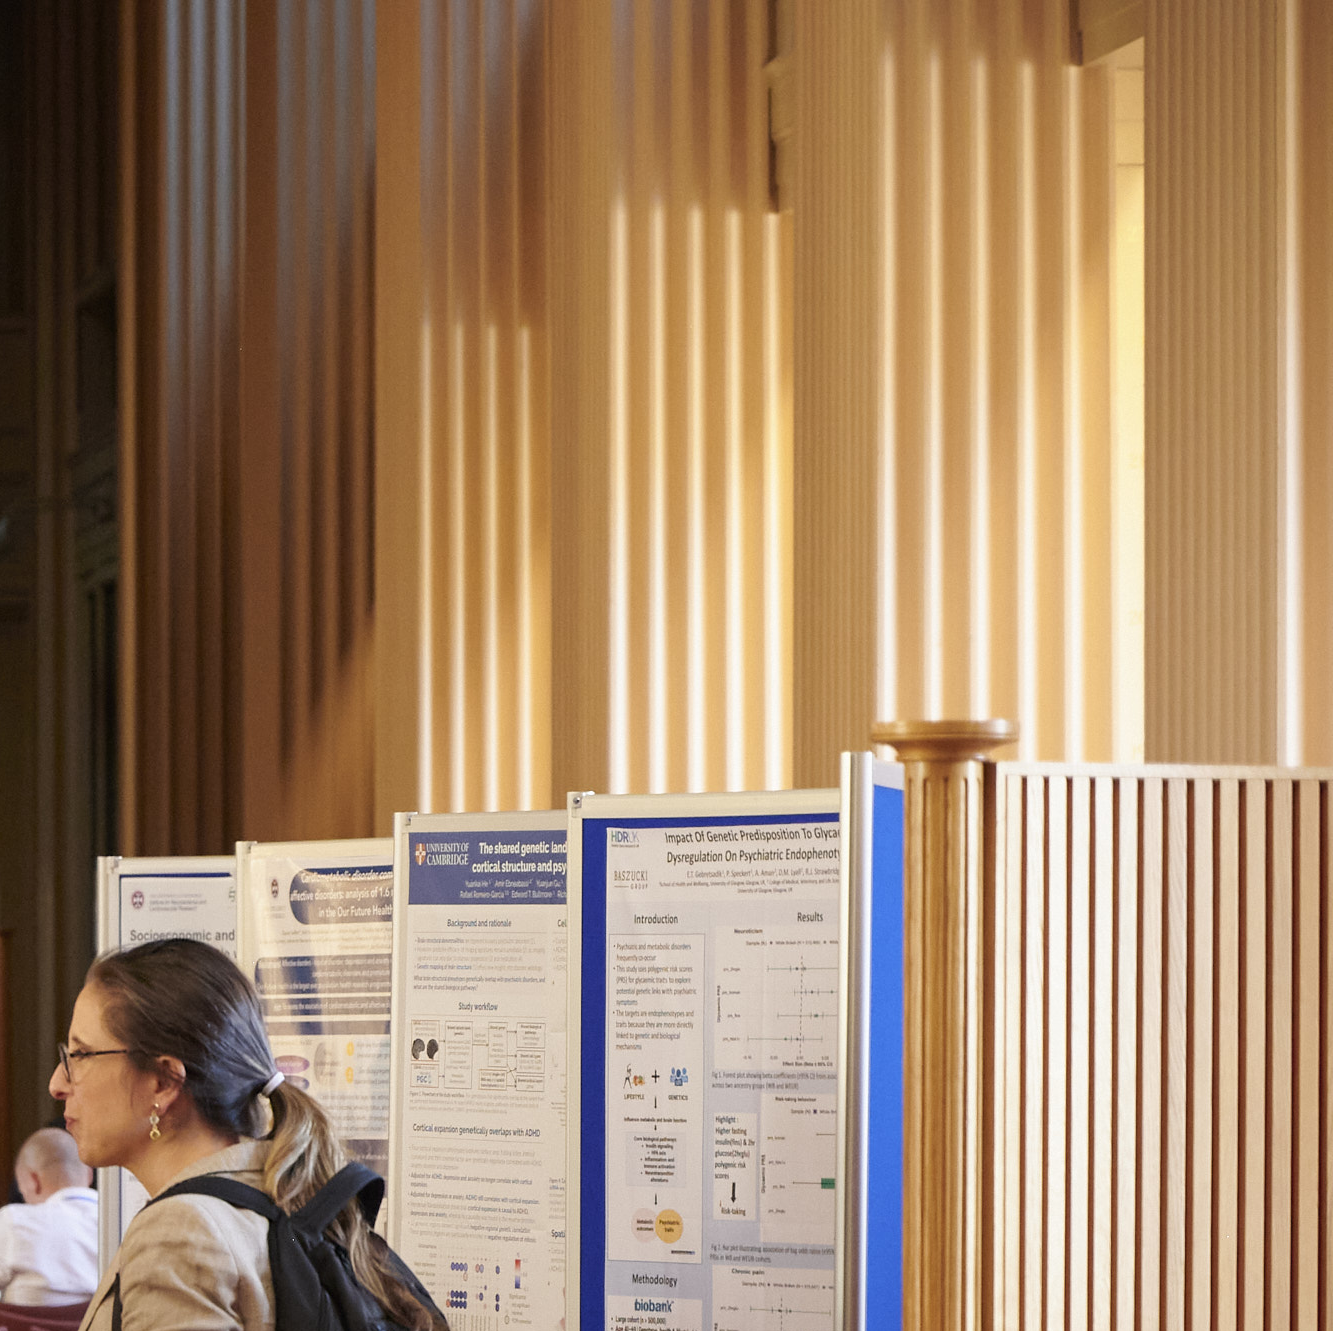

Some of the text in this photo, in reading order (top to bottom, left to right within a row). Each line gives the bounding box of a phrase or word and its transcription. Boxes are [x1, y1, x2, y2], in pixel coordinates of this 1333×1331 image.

[666, 832, 692, 845] Impact
[694, 831, 704, 843] Of
[707, 830, 737, 842] Genetic
[740, 829, 800, 844] Predisposition
[479, 842, 493, 854] The
[495, 842, 520, 854] shared
[521, 841, 549, 856] genetic
[667, 851, 722, 865] Dysregulation
[739, 850, 783, 862] Psychiatric
[472, 861, 500, 873] cortical
[346, 889, 369, 901] analysis
[130, 929, 212, 941] Socioeconomic
[459, 1125, 488, 1137] genetically
[632, 1274, 677, 1286] Methodology
[634, 1299, 673, 1312] biobank
